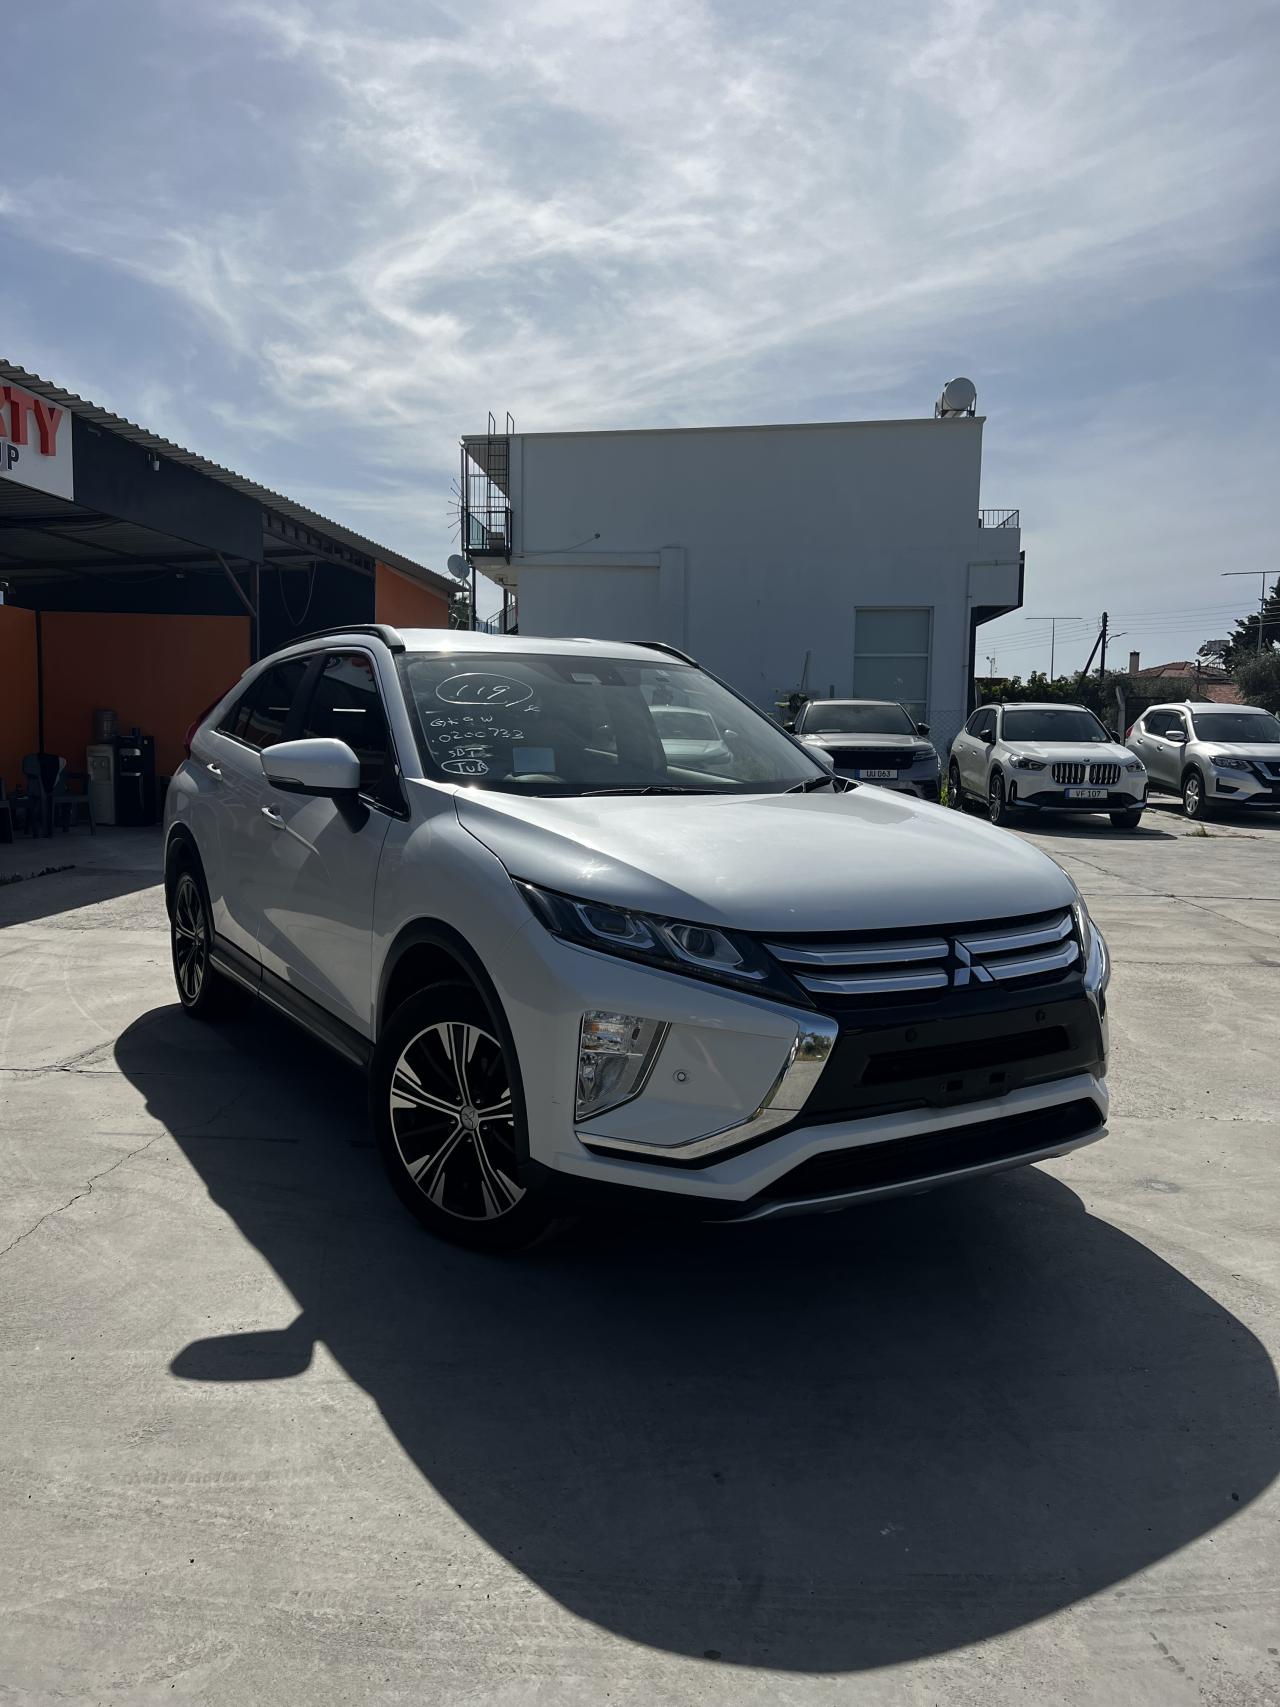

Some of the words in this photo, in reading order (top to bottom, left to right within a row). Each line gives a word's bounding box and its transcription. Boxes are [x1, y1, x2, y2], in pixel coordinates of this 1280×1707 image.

[0, 440, 20, 471] P
[1075, 790, 1086, 798] VF
[1087, 790, 1101, 798] 107
